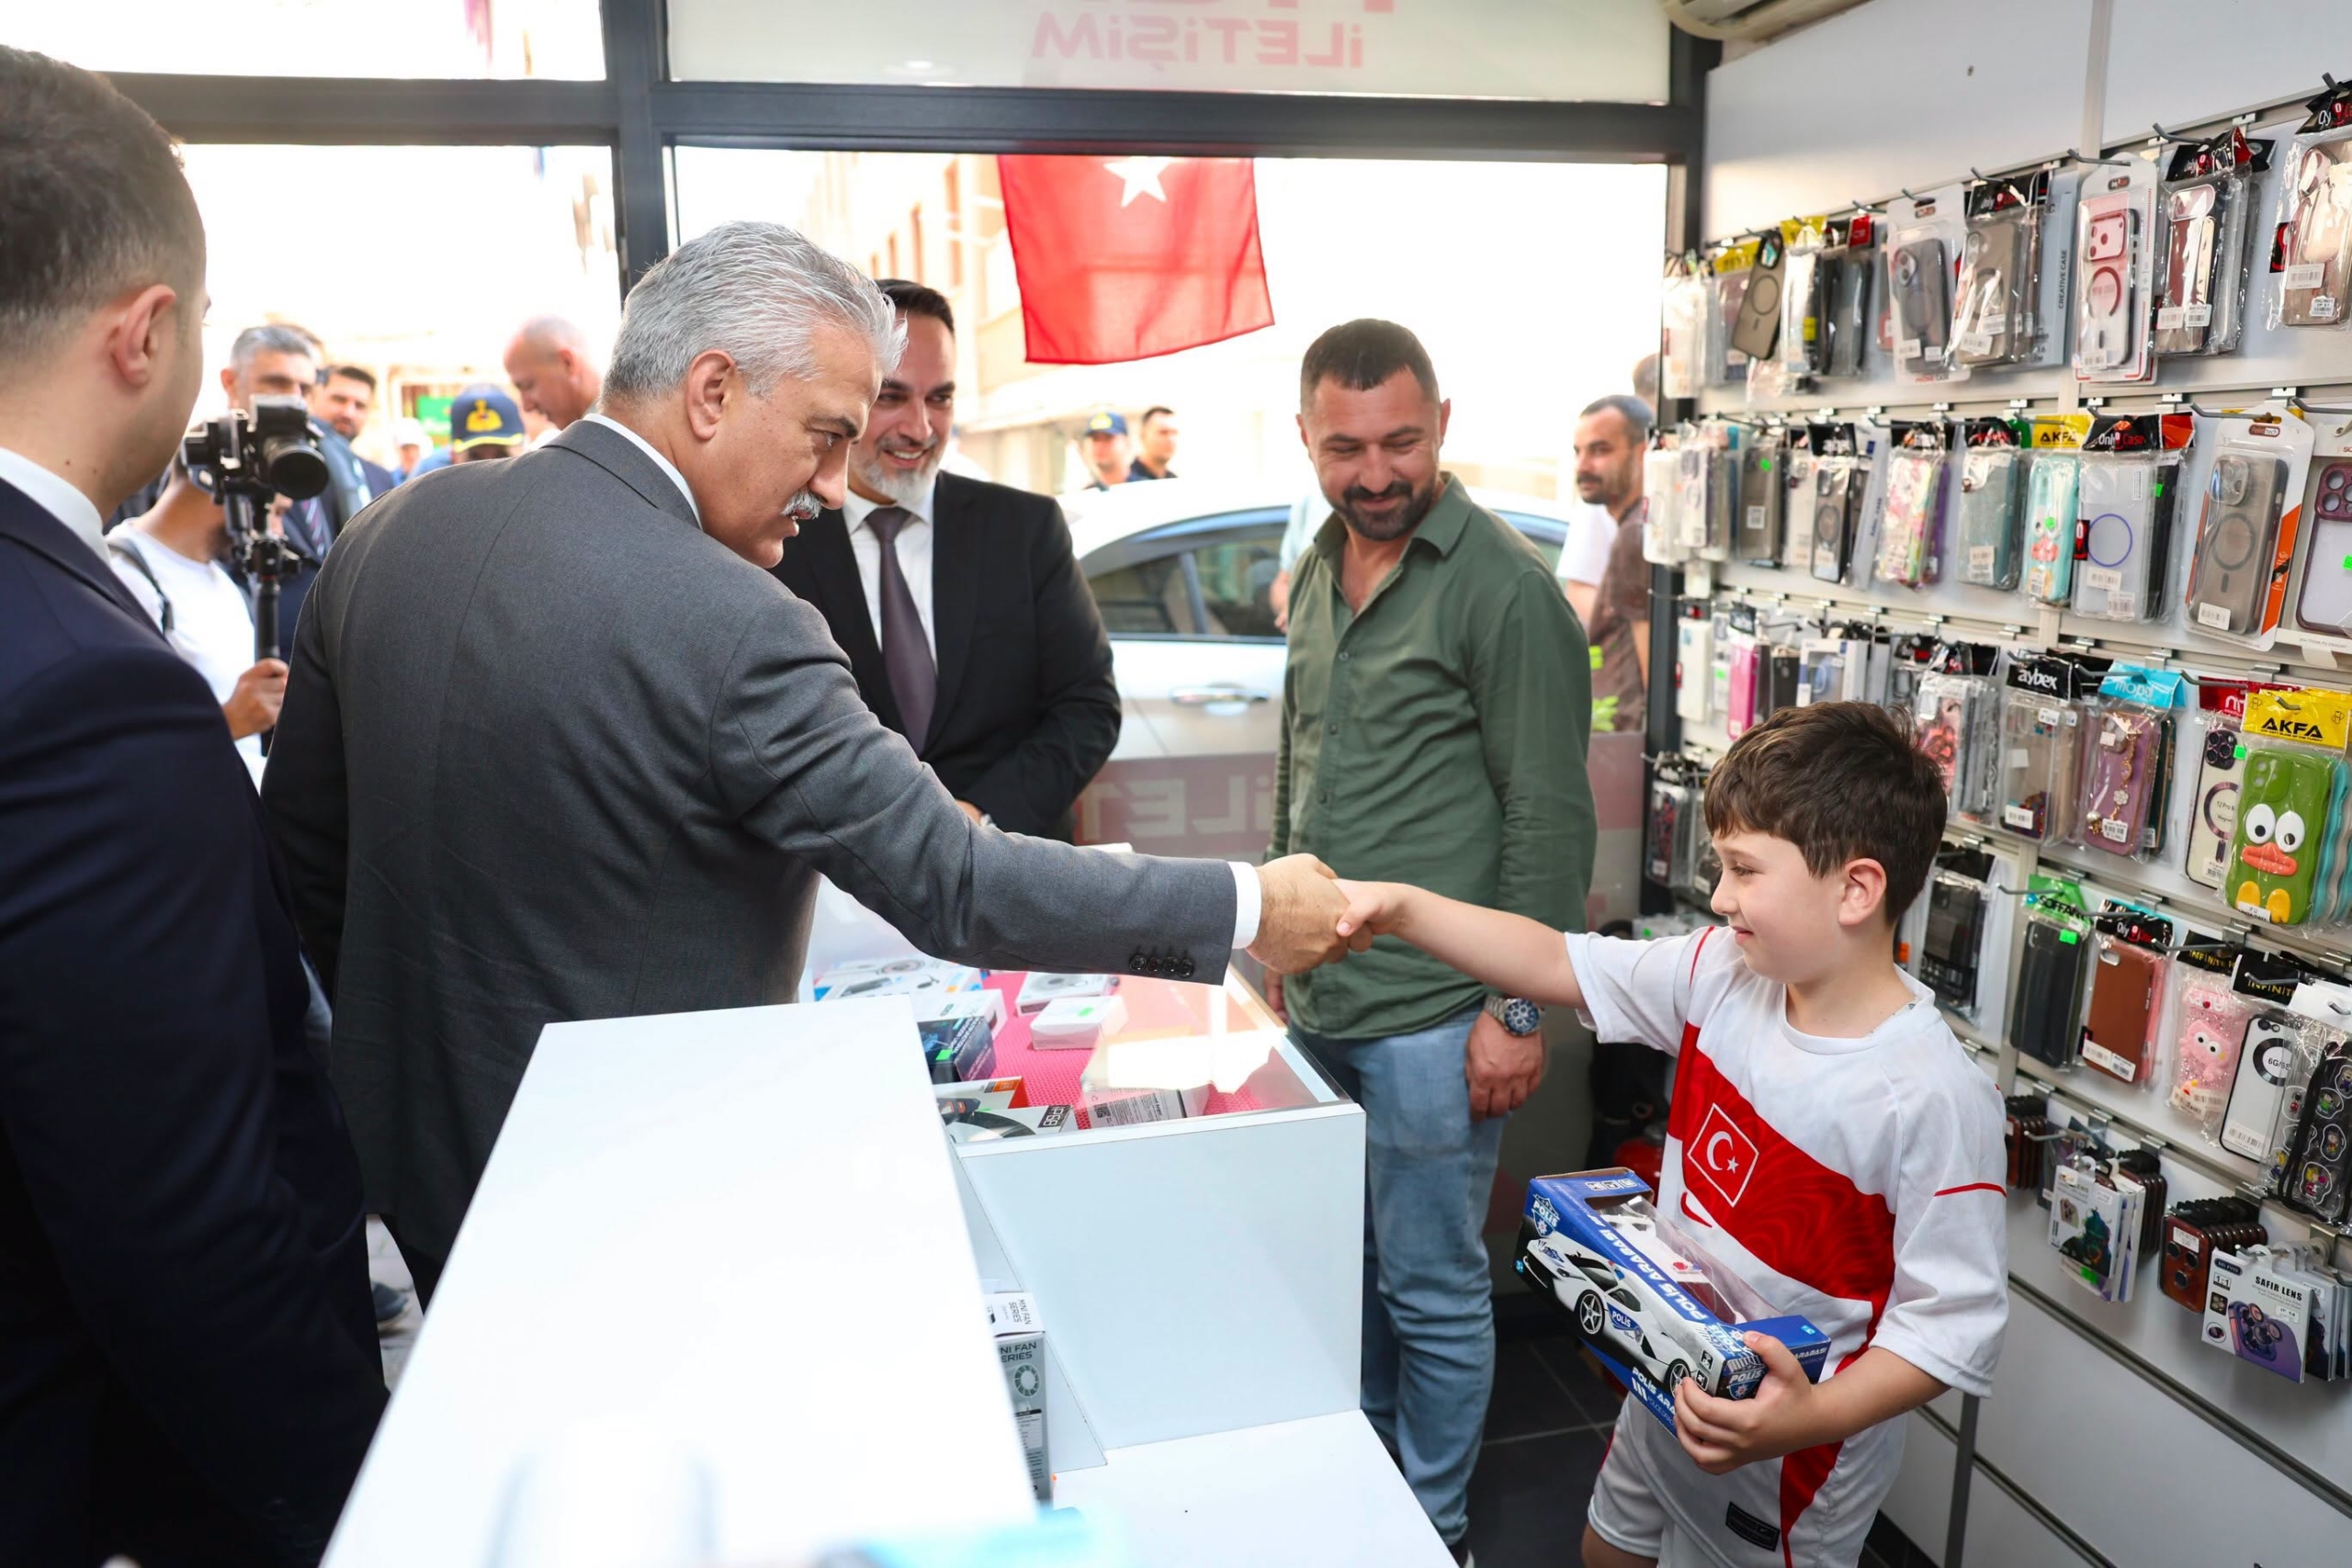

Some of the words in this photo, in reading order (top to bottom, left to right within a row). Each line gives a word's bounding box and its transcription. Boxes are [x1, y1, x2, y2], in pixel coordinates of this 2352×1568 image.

[2058, 273, 2067, 309] CREATIVE
[2017, 668, 2058, 690] aybex
[2261, 717, 2324, 739] AKFA
[1599, 1229, 1668, 1281] ARABASI
[2256, 1276, 2279, 1292] SAFIR
[2281, 1287, 2302, 1302] LENS
[1008, 1302, 1023, 1323] SERIES
[1023, 1312, 1032, 1325] FAN
[1001, 1350, 1033, 1362] ERIES
[1013, 1341, 1036, 1353] FAN
